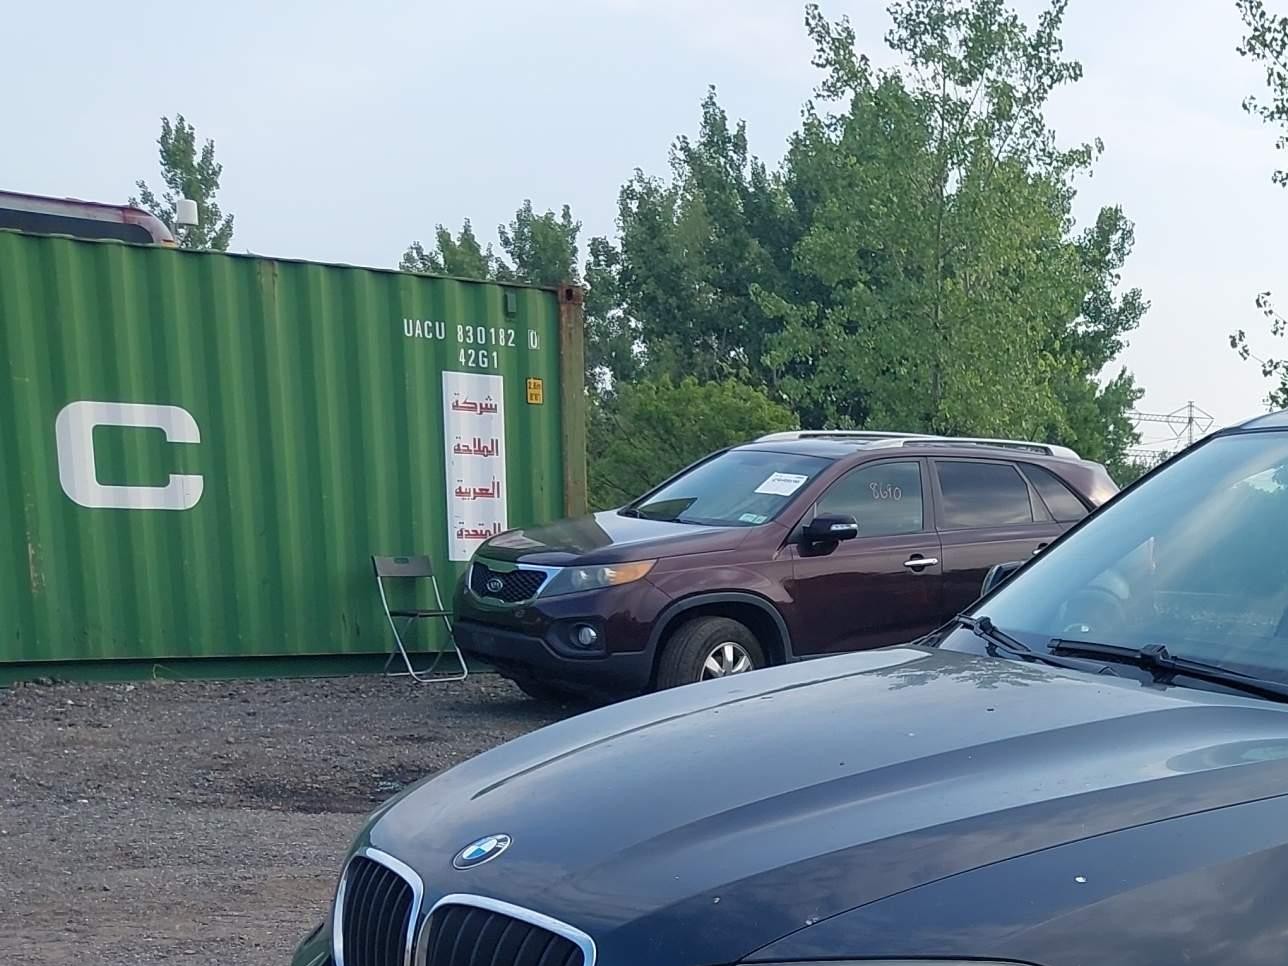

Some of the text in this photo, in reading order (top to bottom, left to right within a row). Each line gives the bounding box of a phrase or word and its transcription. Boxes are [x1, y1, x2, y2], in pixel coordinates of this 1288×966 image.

[403, 318, 445, 340] UACU
[456, 324, 516, 347] 830182
[459, 348, 498, 369] 42G1
[452, 393, 498, 415] شركة
[55, 400, 204, 510] C
[453, 436, 499, 457] الملاحة
[454, 478, 500, 500] العربية
